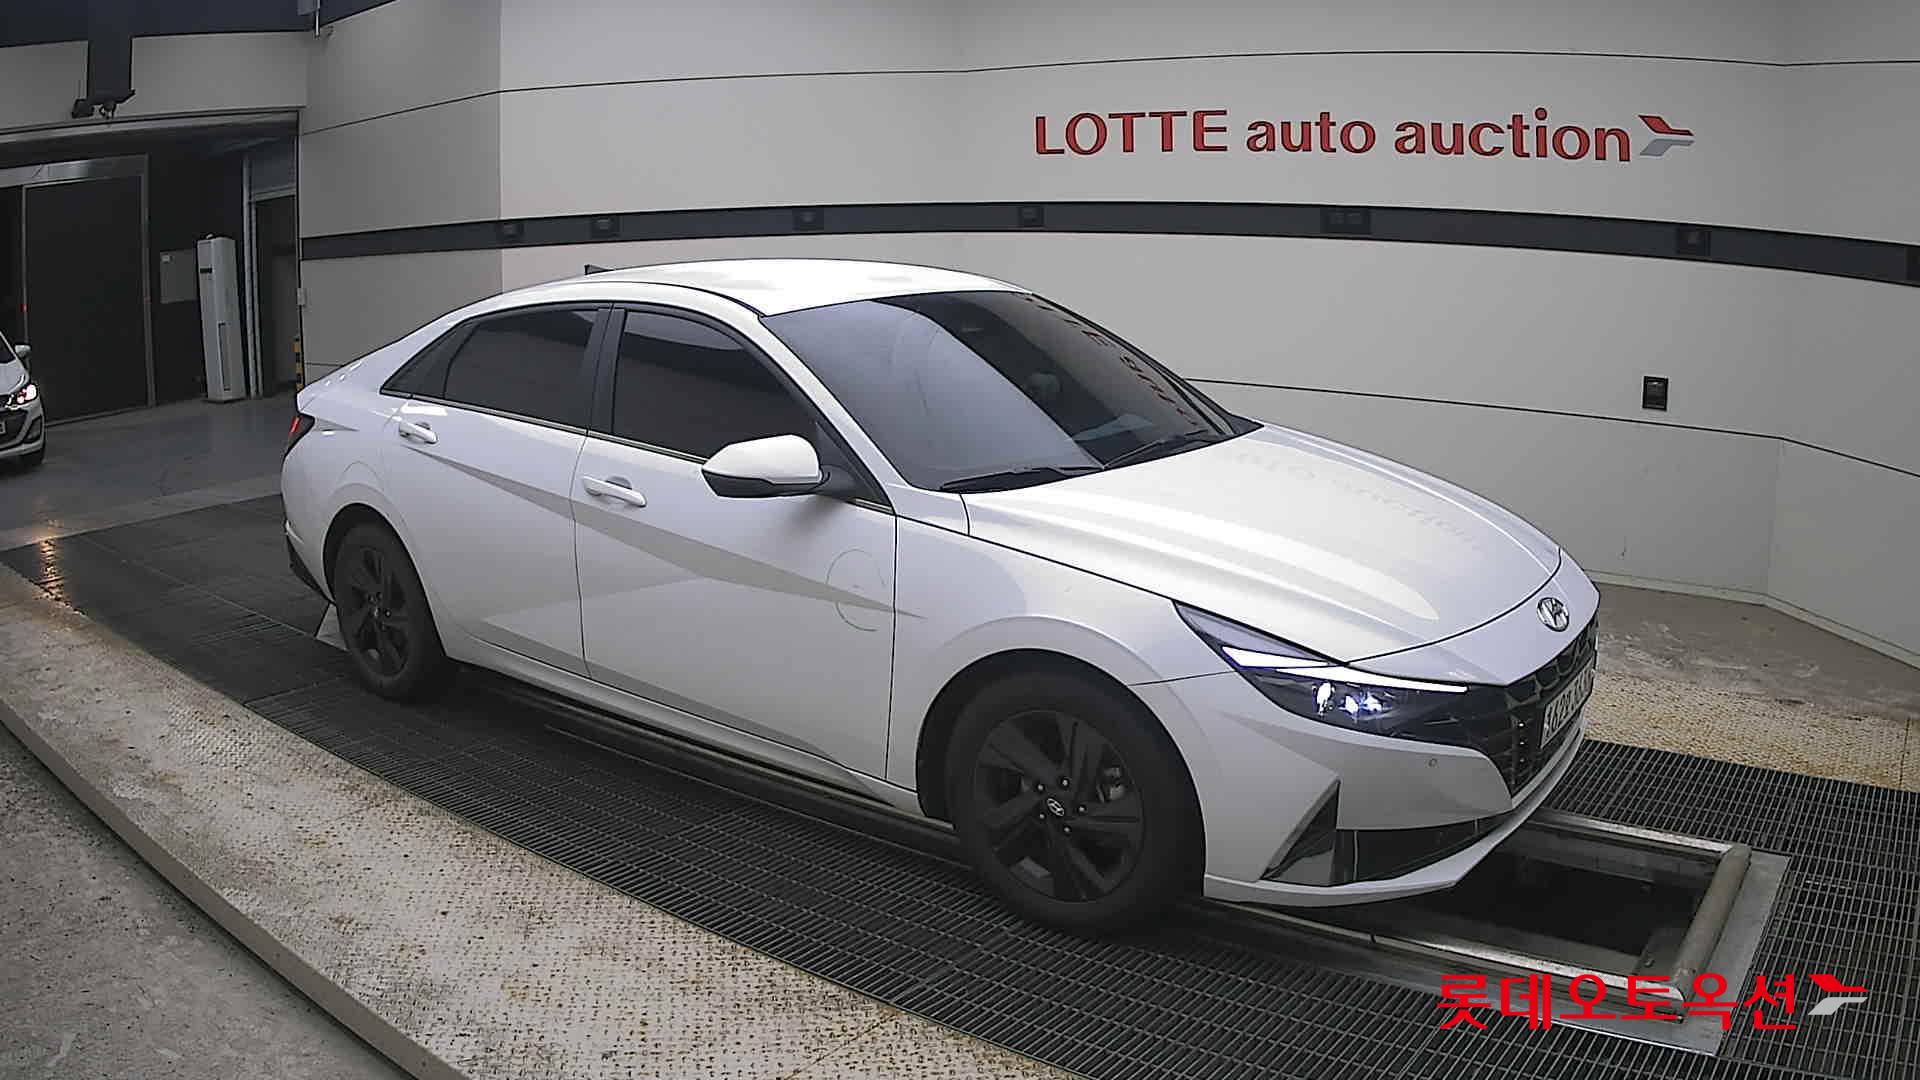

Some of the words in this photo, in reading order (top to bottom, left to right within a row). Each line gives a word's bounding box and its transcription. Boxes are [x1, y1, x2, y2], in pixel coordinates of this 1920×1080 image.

[1035, 110, 1228, 154] LOTTE
[1246, 111, 1376, 153] auto
[1395, 108, 1631, 161] auction
